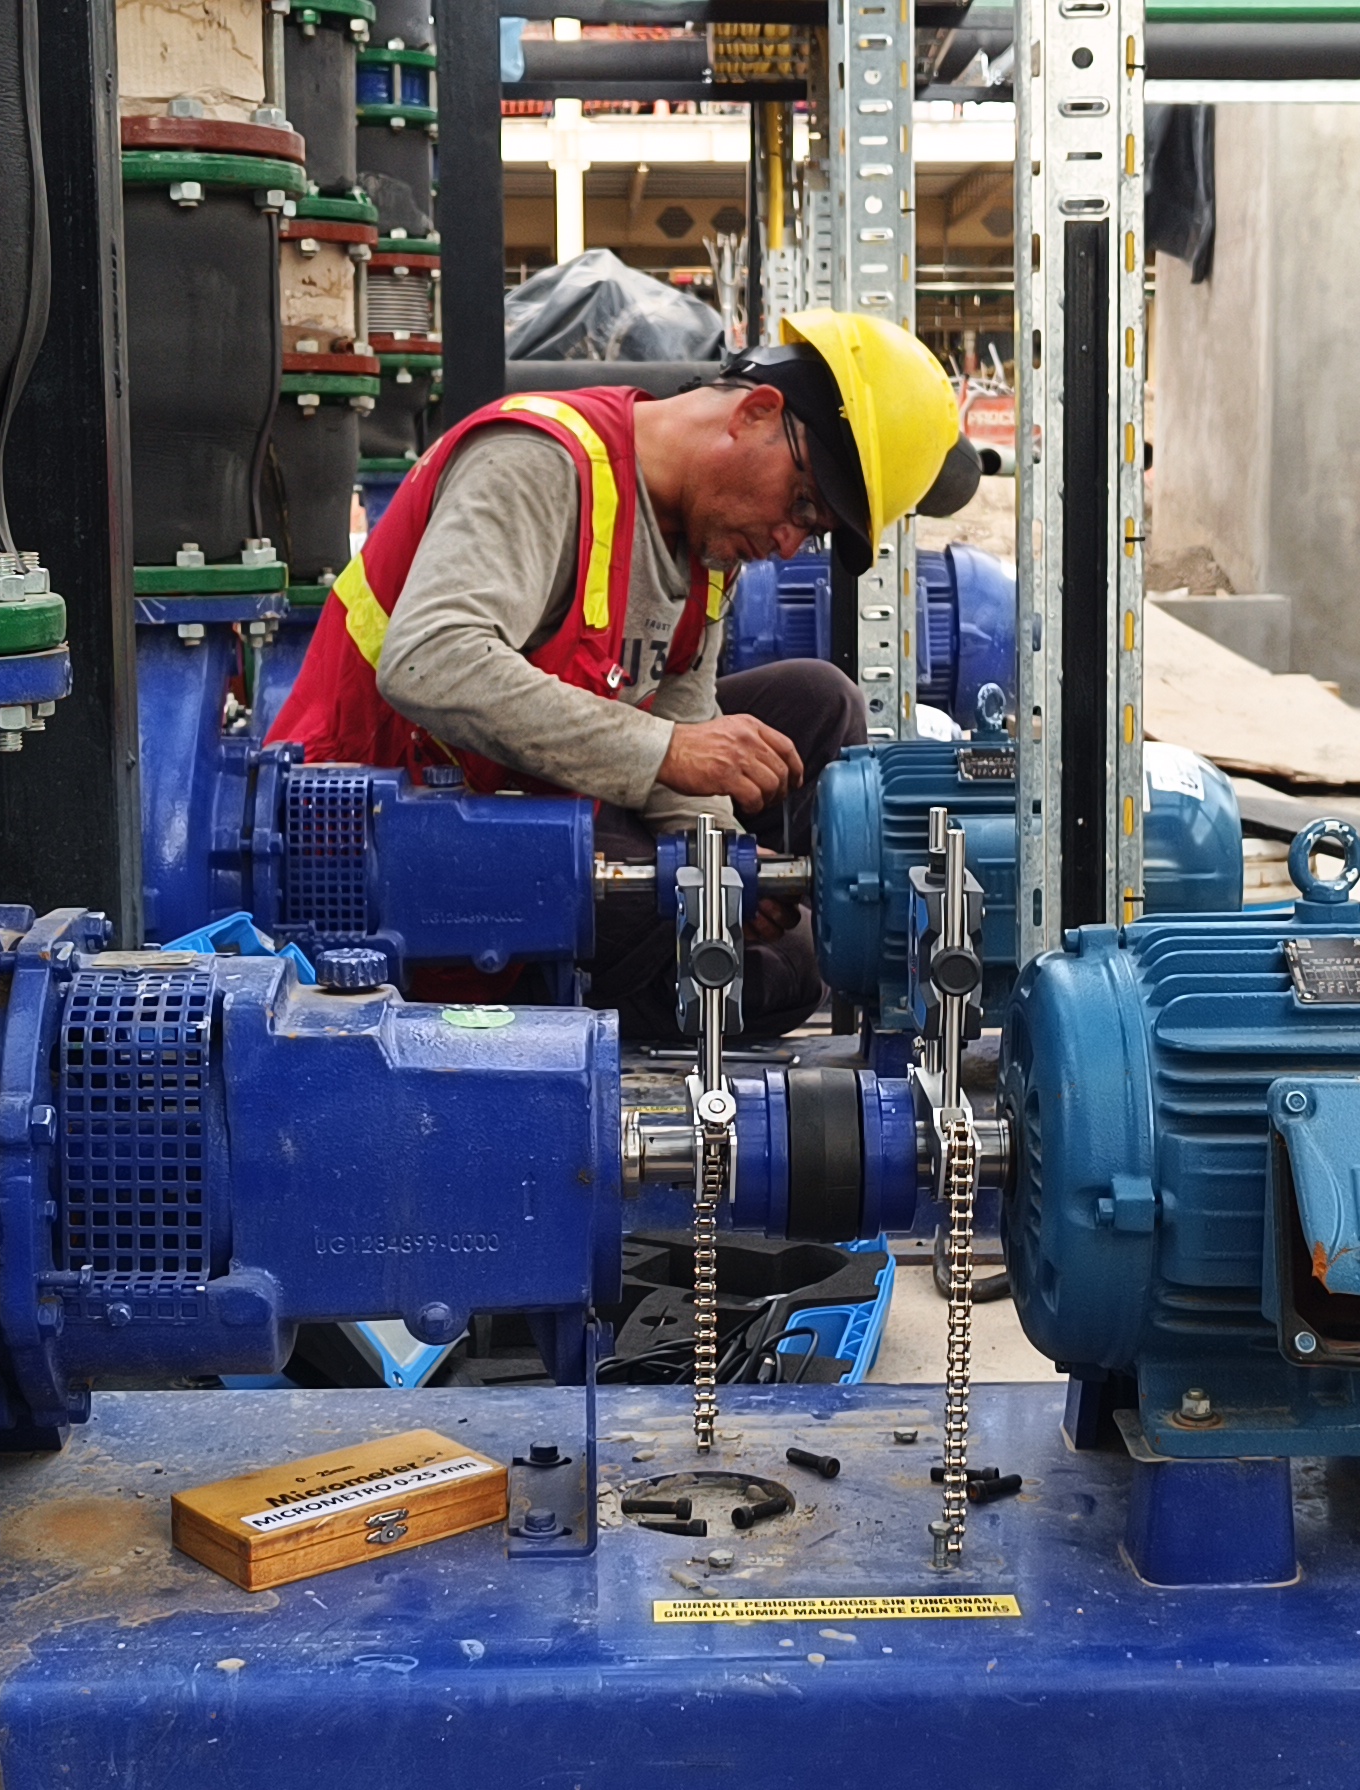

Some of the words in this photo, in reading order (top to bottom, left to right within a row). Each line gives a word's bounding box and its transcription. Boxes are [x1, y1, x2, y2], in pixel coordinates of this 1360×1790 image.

[252, 1483, 392, 1527] MICROMETRO
[393, 1471, 437, 1486] 0-25
[439, 1462, 478, 1475] mm
[265, 1462, 420, 1508] Micrometer
[664, 1610, 708, 1618] GIRAR
[735, 1608, 789, 1617] BOMBA
[793, 1606, 907, 1616] MANUALMENTE
[910, 1605, 951, 1614] CADA
[954, 1605, 973, 1613] 30
[672, 1601, 739, 1610] DURANTE
[821, 1599, 877, 1607] LARGOS
[882, 1598, 905, 1606] SIN
